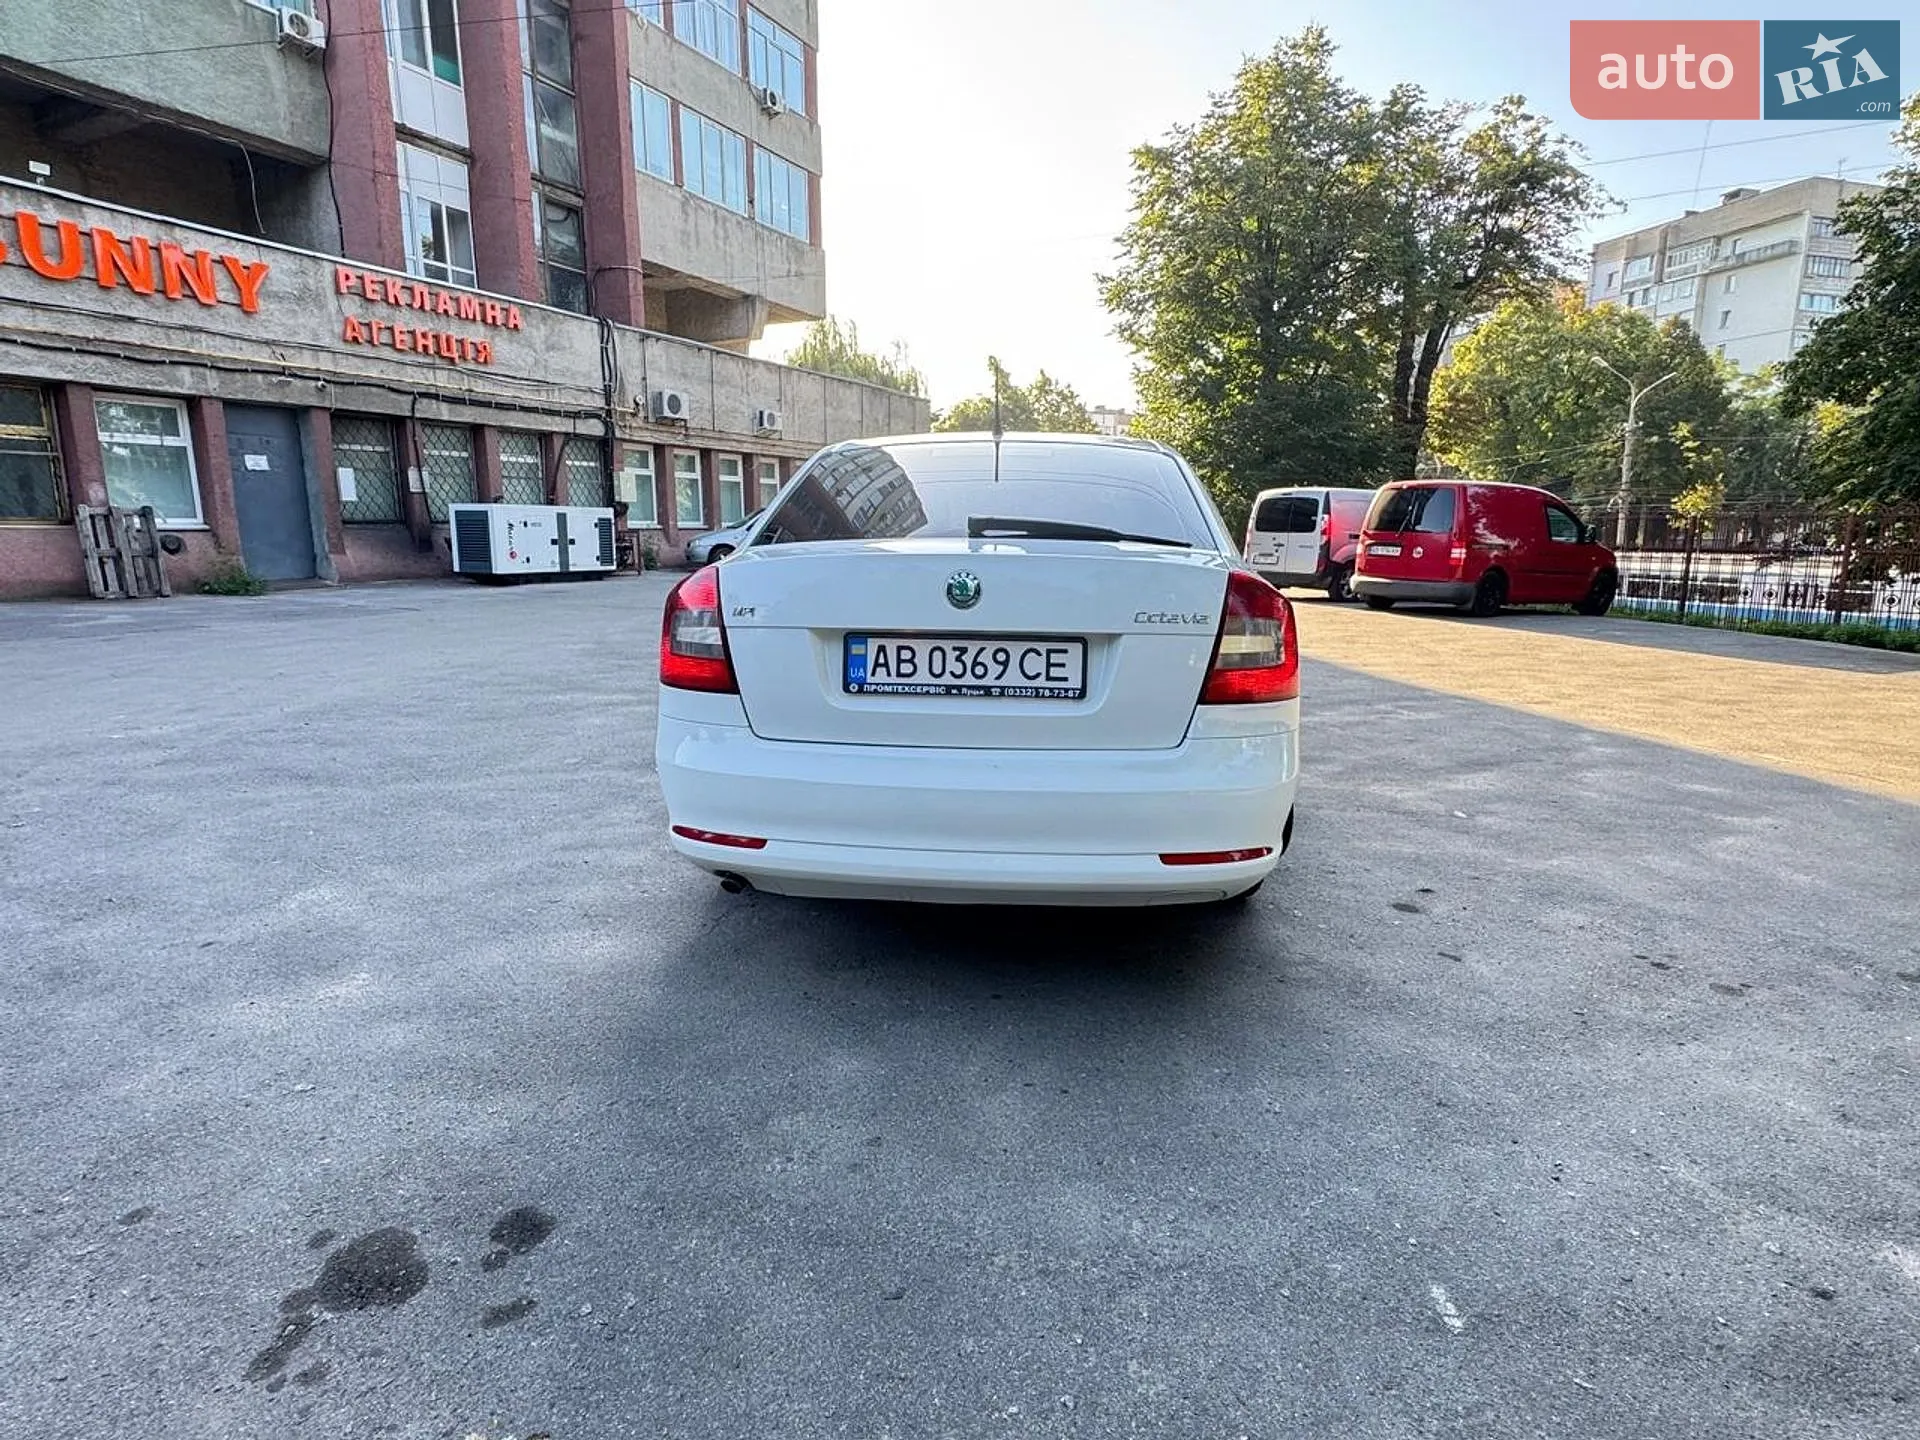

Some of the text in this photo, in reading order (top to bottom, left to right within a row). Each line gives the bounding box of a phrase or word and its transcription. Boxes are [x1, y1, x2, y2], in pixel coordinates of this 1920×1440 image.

[0, 208, 271, 314] UNNY
[335, 264, 524, 332] РЕКЛАМНА
[343, 313, 496, 365] АГЕНЦІЯ
[1134, 611, 1210, 624] Octavia
[850, 667, 865, 678] UA
[870, 644, 1069, 682] AB 0369 CE
